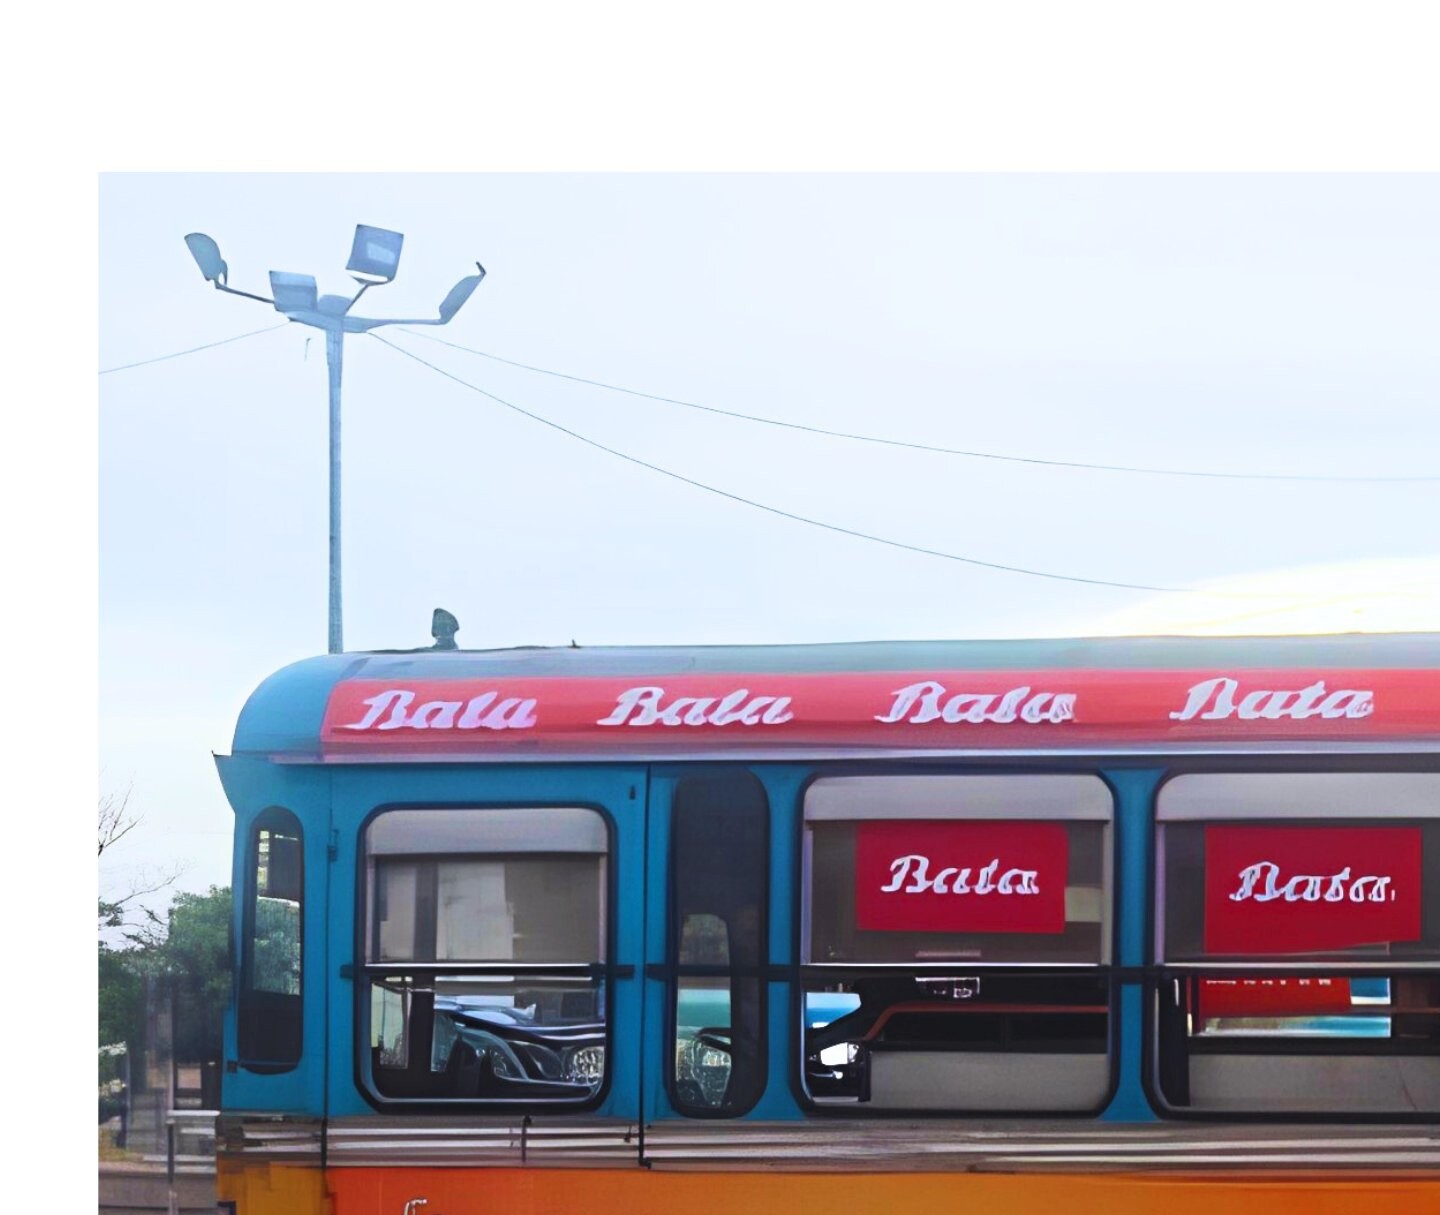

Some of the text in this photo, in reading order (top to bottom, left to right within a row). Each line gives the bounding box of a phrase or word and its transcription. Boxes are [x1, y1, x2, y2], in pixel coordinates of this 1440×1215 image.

[342, 690, 536, 729] Bata
[597, 686, 793, 725] Bata
[875, 681, 1076, 723] Bata
[1170, 677, 1373, 720] Bata
[881, 855, 1039, 894] Bata
[1229, 862, 1395, 902] Bata
